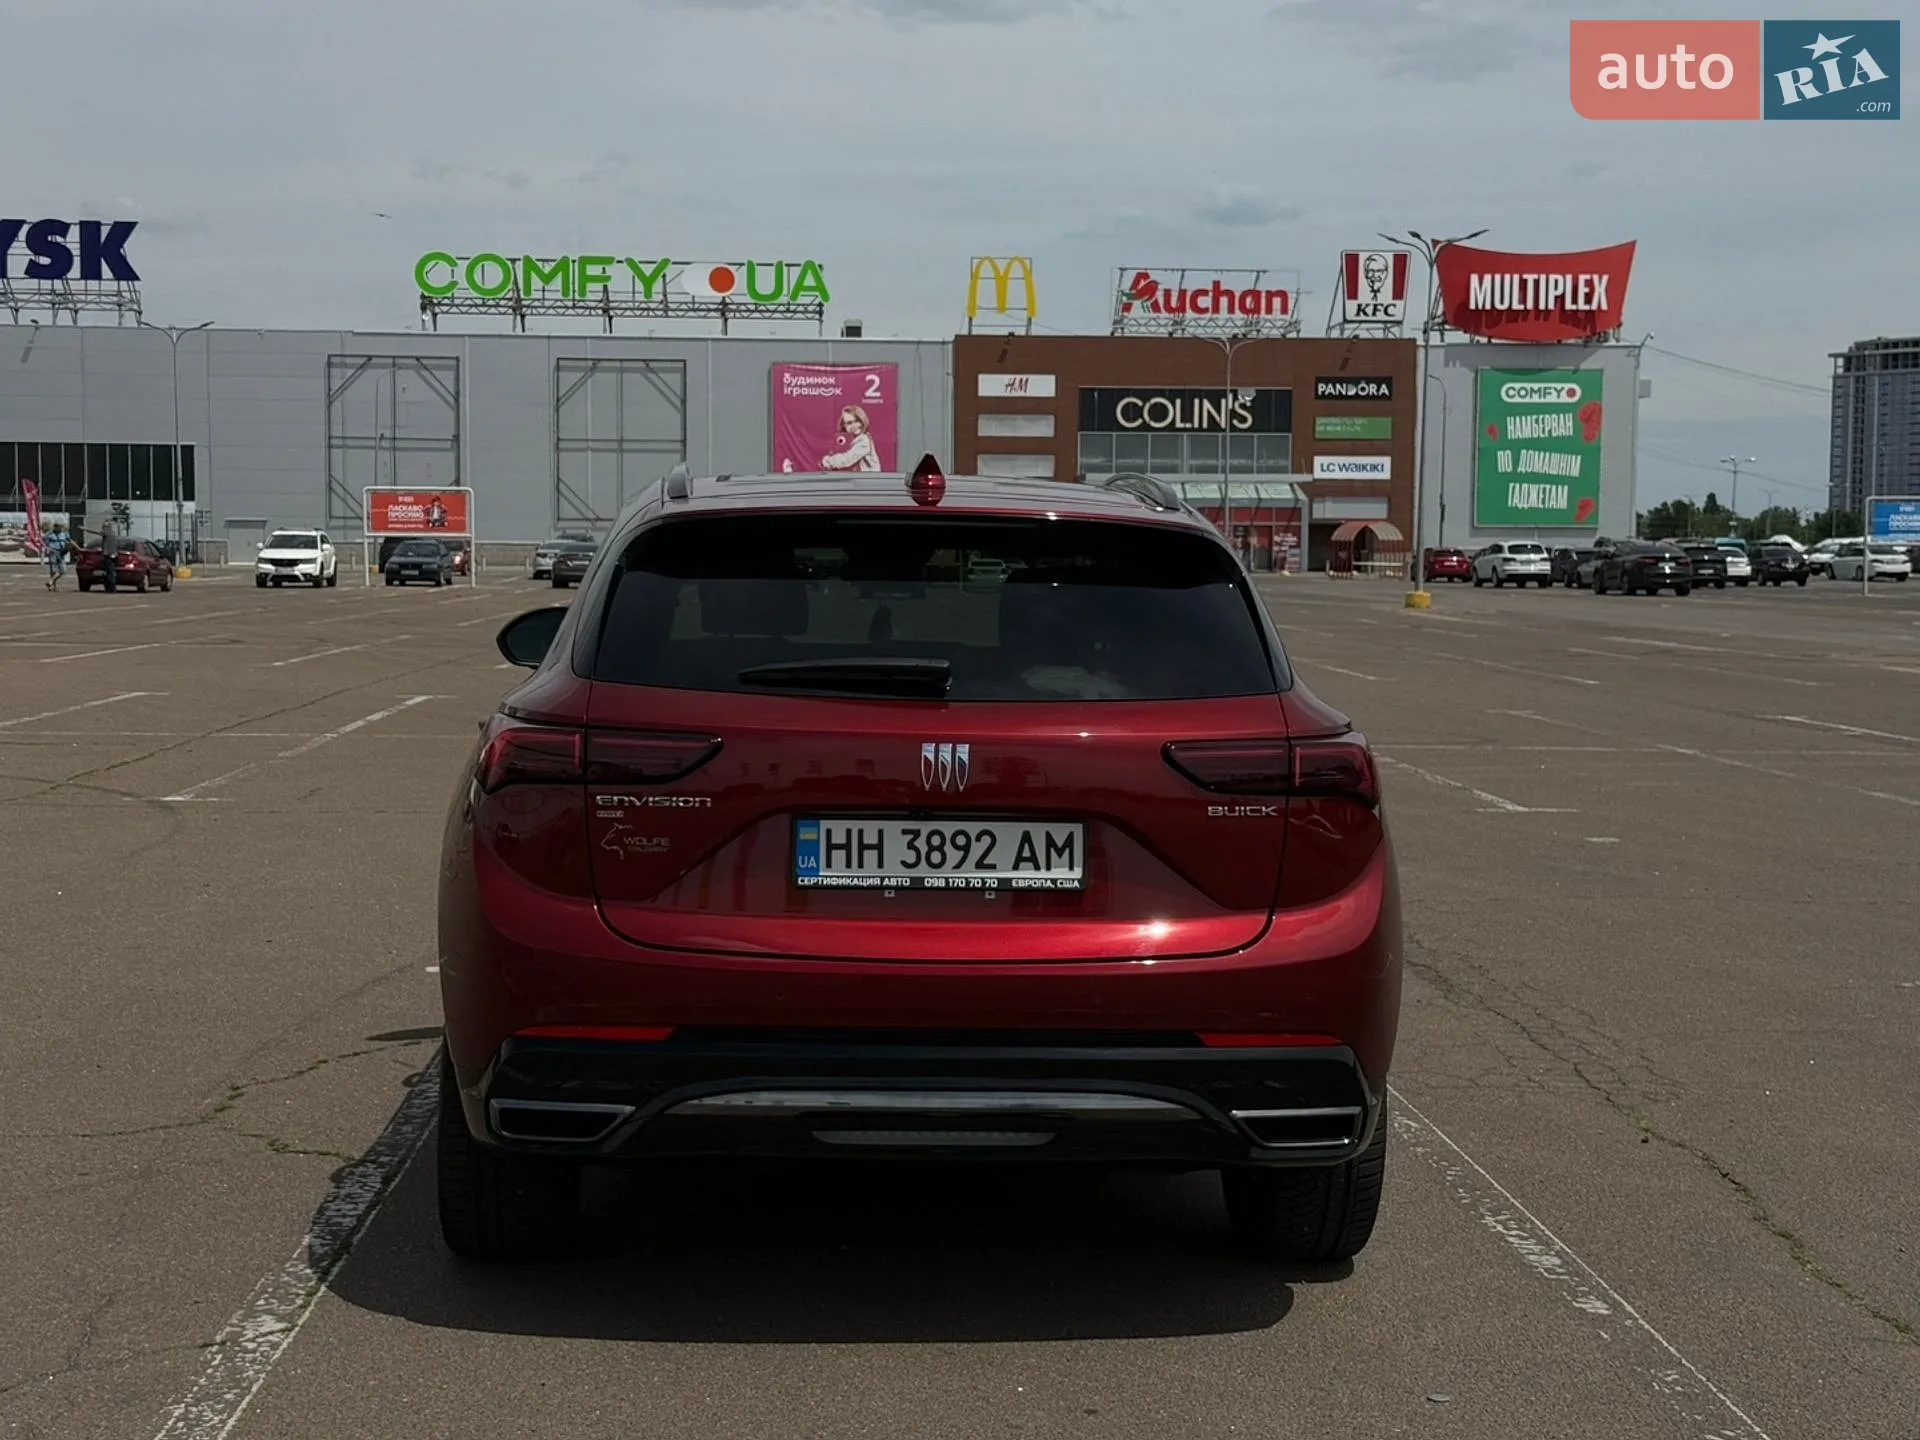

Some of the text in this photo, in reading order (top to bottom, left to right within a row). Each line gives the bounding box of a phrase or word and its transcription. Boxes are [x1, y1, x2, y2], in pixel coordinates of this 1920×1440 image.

[414, 251, 831, 304] COMFY UA
[1120, 271, 1288, 316] Auchan
[1469, 273, 1610, 311] MULTIPLEX
[1354, 303, 1397, 318] KFC
[864, 374, 881, 397] 2
[1318, 380, 1390, 396] PANDORA
[1505, 386, 1564, 399] COMFY
[1116, 392, 1253, 430] COLIN'S
[1506, 413, 1574, 440] НАМБЕРВАН
[1320, 463, 1336, 473] LC
[1497, 449, 1582, 477] ПО ДОМАШНІМ
[1507, 482, 1568, 509] ГАДЖЕТАМ
[596, 795, 711, 807] ENVISION
[1207, 806, 1278, 816] BUICK
[825, 828, 1075, 871] HH 3892 AM
[799, 856, 817, 868] UA
[798, 877, 880, 886] СЕРТИФИКАЦИЯ
[883, 877, 910, 886] АВТО
[924, 878, 945, 887] 098
[949, 878, 965, 887] 170
[968, 878, 982, 887] 70
[985, 878, 998, 887] 70
[1057, 879, 1079, 888] США
